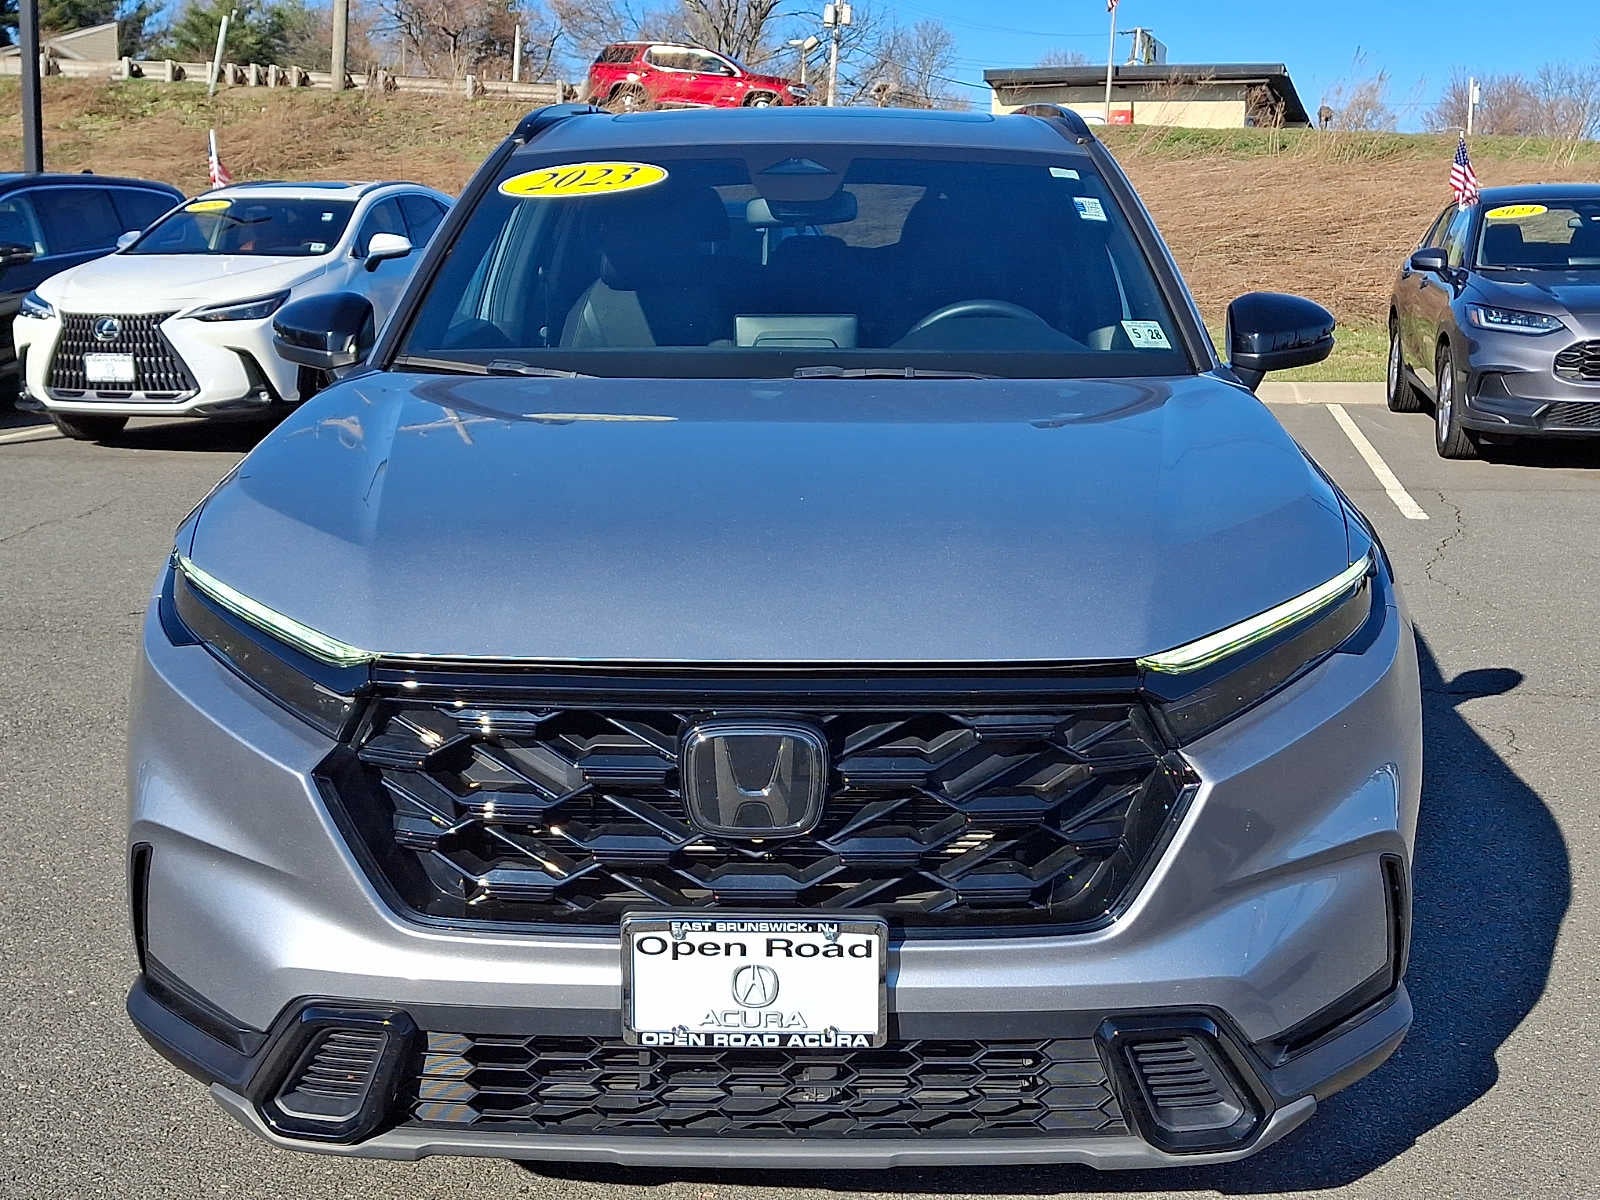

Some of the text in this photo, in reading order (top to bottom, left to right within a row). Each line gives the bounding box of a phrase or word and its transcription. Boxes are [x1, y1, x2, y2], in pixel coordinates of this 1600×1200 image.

[523, 166, 642, 192] 2023
[1131, 328, 1163, 340] 5 28
[670, 921, 839, 933] EAST BRUNSWICK, NJ
[635, 936, 873, 961] Open Road
[699, 1009, 809, 1029] ACURA
[641, 1032, 870, 1048] OPEN ROAD ACURA
